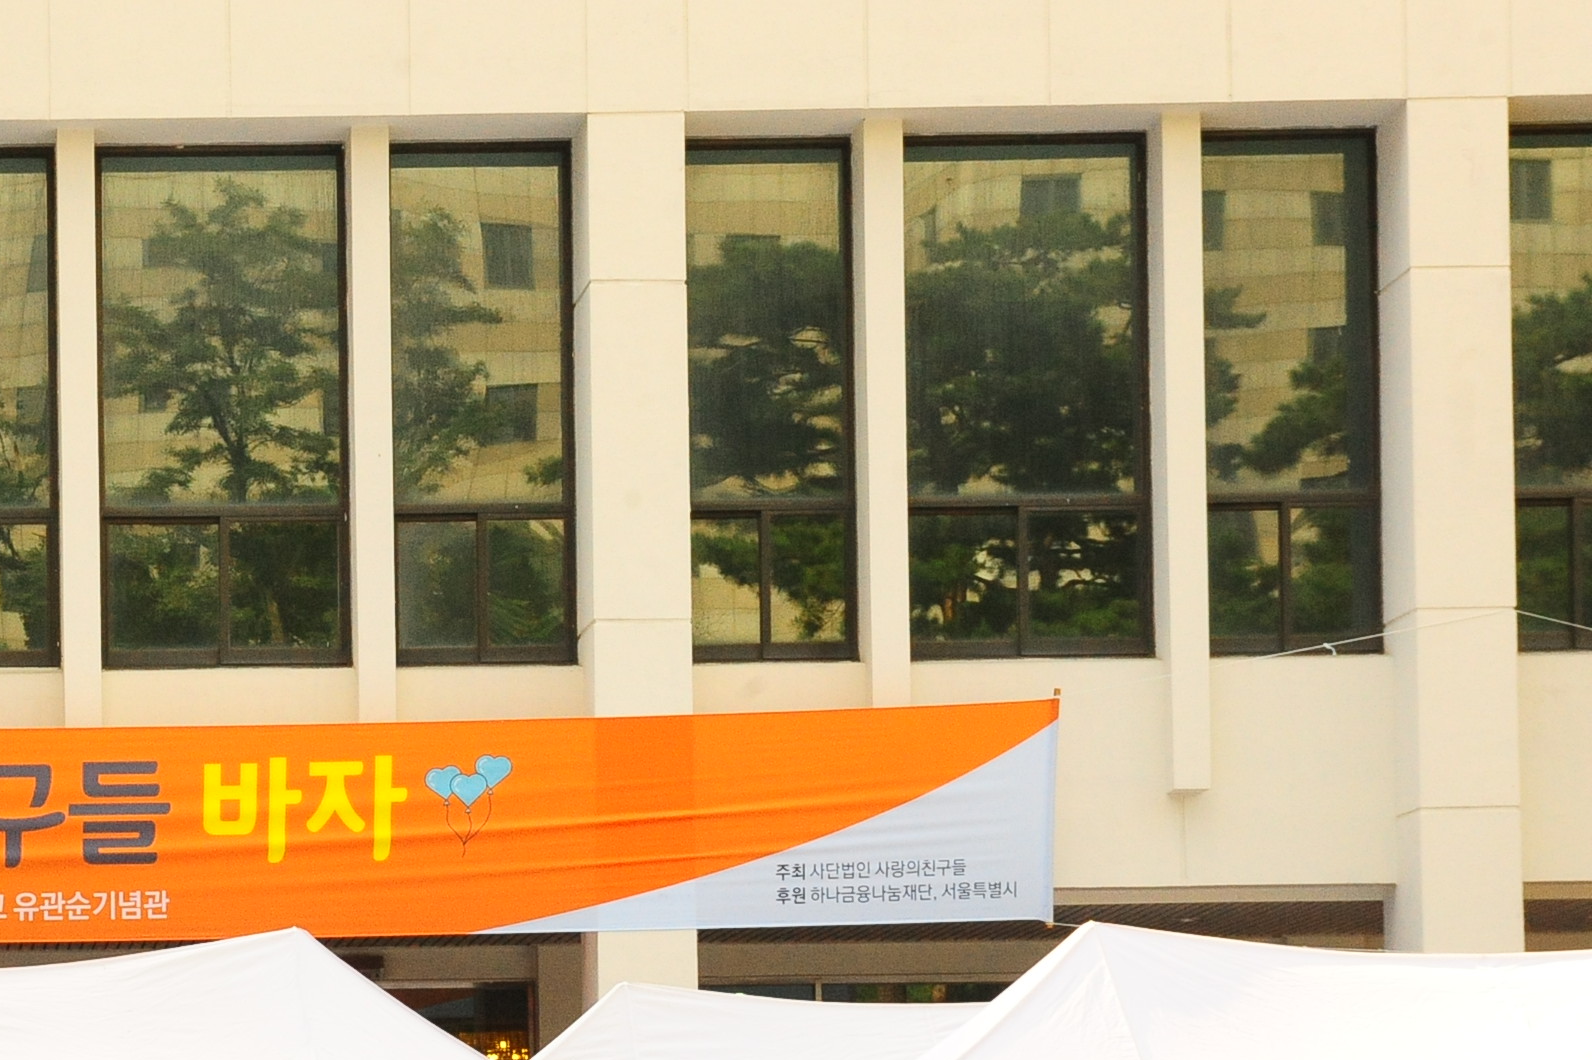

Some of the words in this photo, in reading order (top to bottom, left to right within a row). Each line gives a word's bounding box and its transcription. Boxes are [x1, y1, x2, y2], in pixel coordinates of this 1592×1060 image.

[202, 754, 409, 865] 바자
[775, 862, 806, 881] 주최
[809, 861, 872, 880] 사단법인
[874, 858, 968, 879] 사랑의친구들
[13, 890, 171, 921] 유관순기념관
[775, 886, 806, 905] 후원
[941, 881, 1018, 901] 서울특별시
